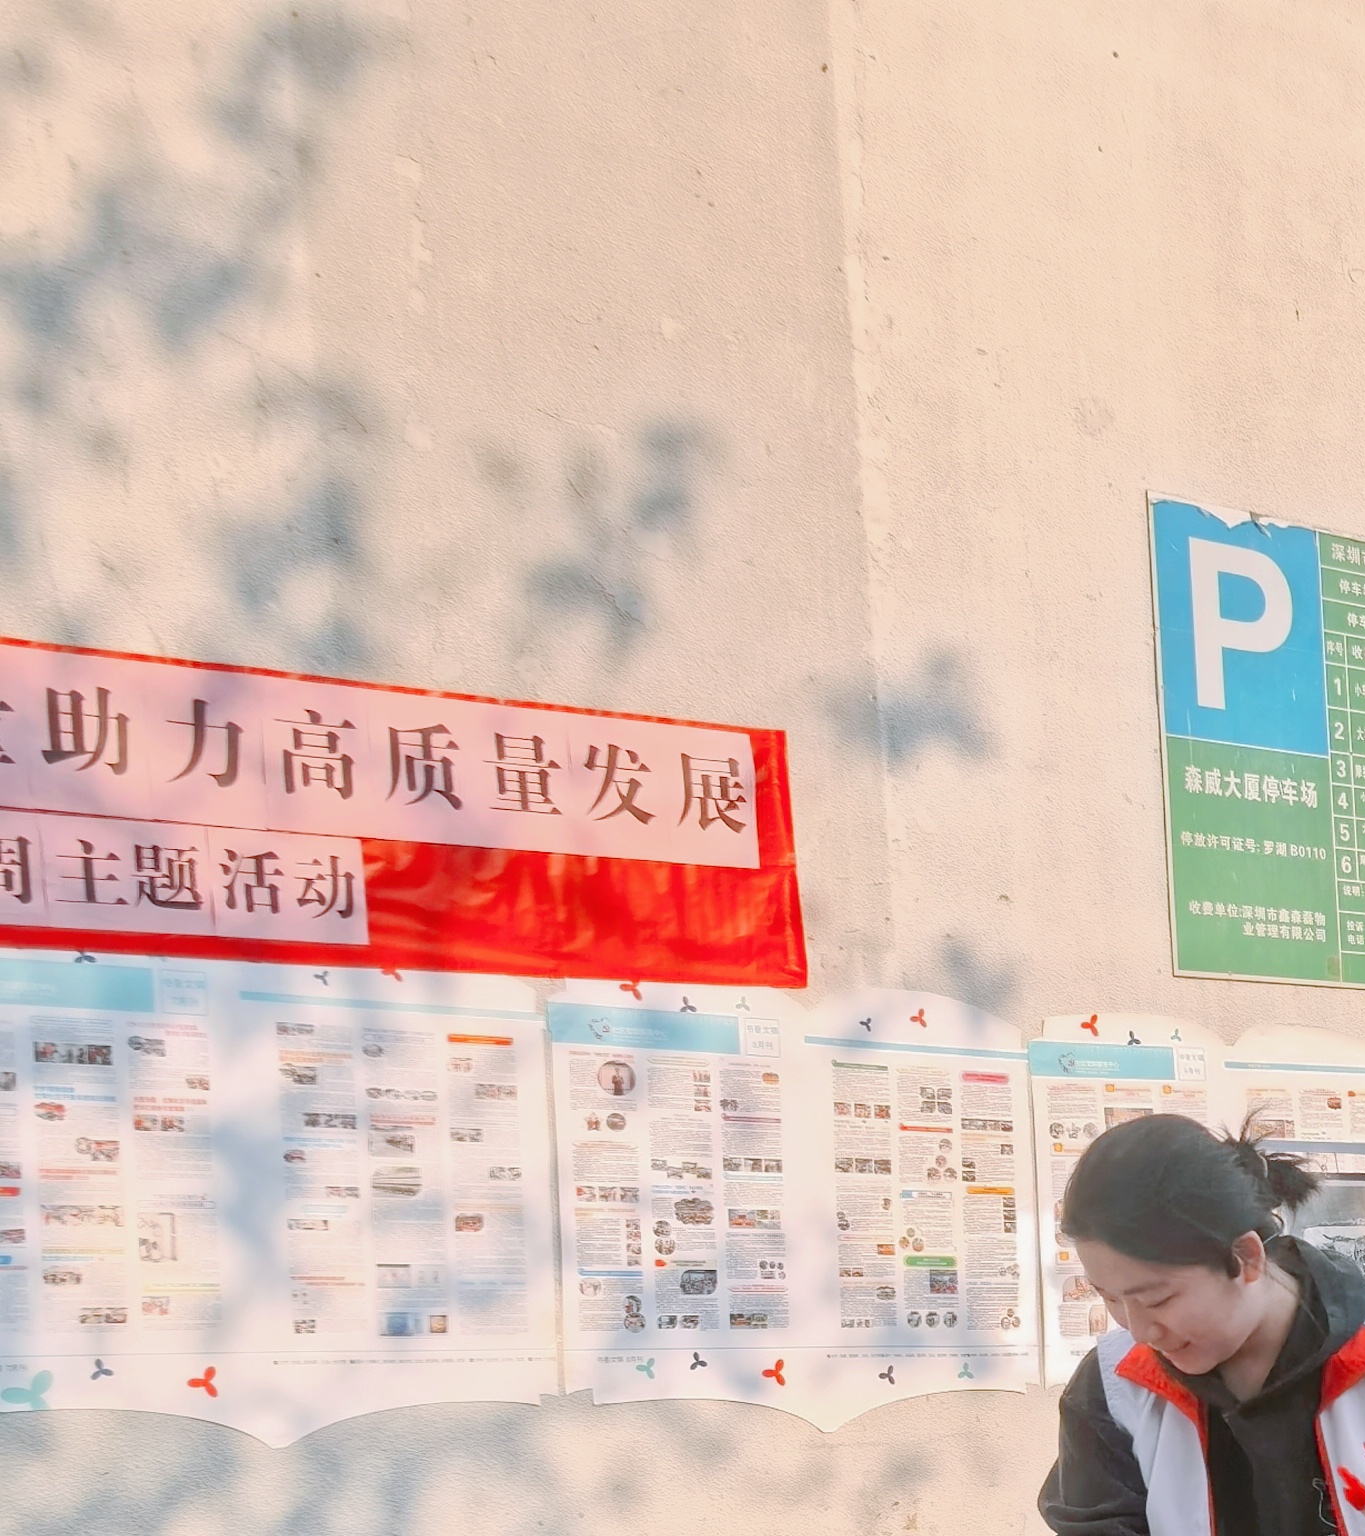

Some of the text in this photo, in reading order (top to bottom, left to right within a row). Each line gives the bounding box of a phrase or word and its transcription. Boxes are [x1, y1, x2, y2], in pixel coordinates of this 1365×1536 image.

[1189, 537, 1293, 710] P
[1326, 640, 1343, 658] 序号
[1334, 678, 1342, 696] 1
[1334, 722, 1345, 741] 2
[0, 686, 749, 833] 助力高质量发展
[1336, 760, 1347, 778] 3
[1185, 764, 1318, 809] 森威大厦停车场
[1337, 792, 1349, 810] 4
[1339, 823, 1350, 842] 5
[1290, 844, 1326, 860] B0110
[1341, 855, 1352, 873] 6
[1242, 922, 1326, 942] 业管理有限公司
[1346, 920, 1364, 932] 投诉
[1347, 934, 1365, 945] 电话
